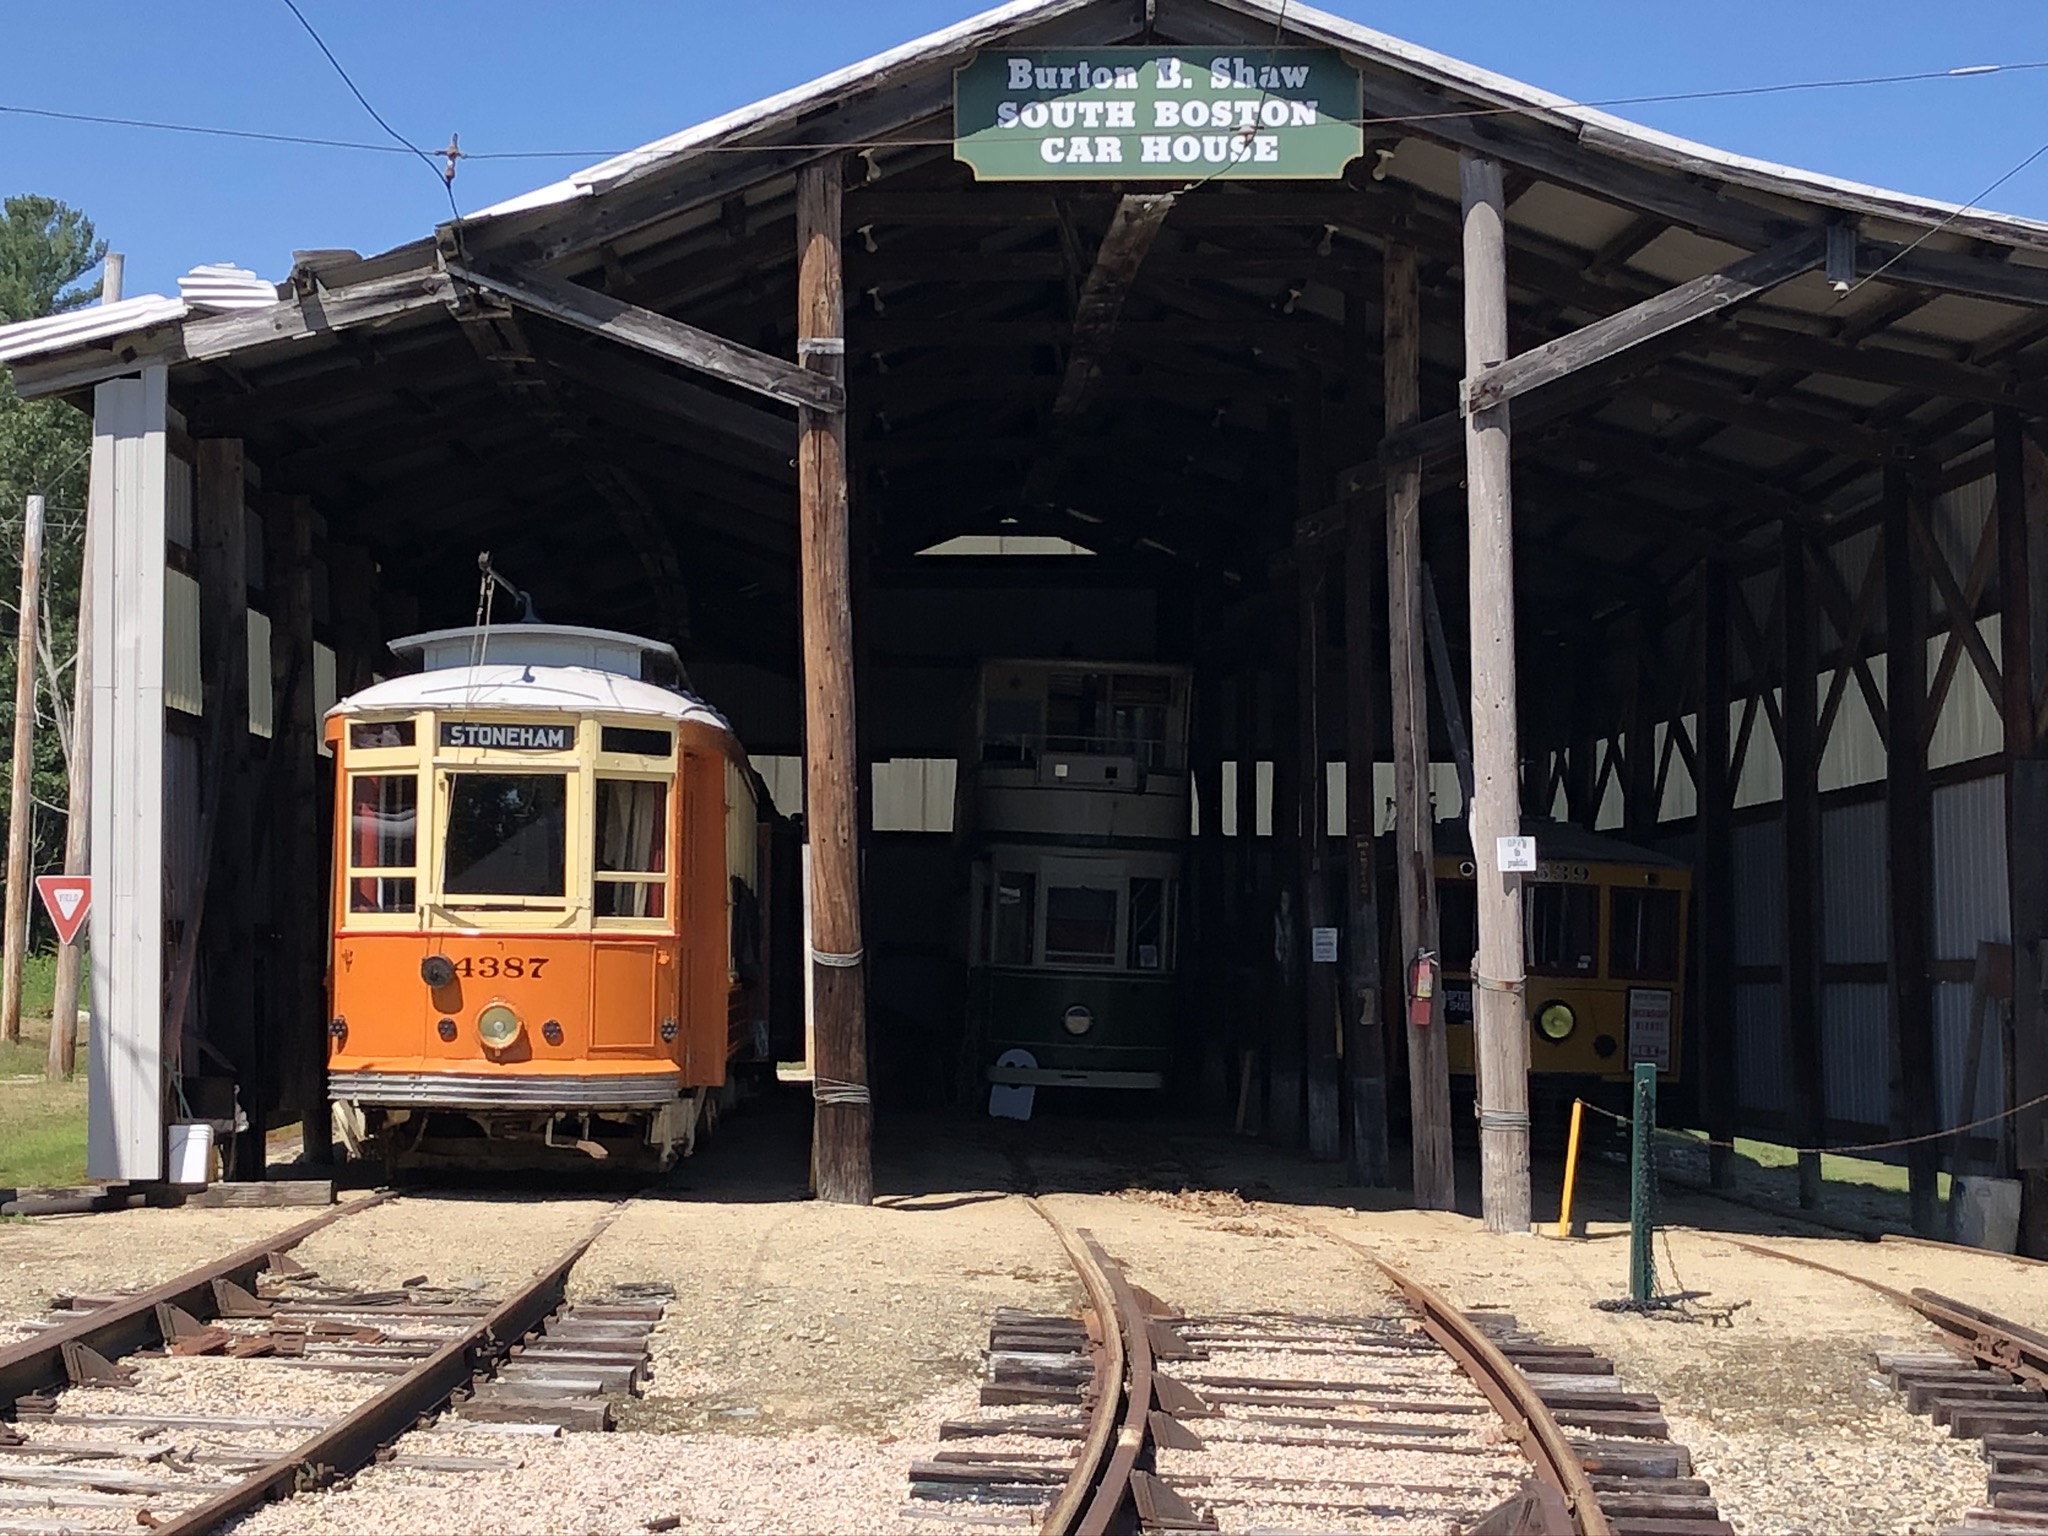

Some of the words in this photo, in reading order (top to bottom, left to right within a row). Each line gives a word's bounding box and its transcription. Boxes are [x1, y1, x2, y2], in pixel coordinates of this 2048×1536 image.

[1008, 58, 1138, 90] Burton
[1156, 58, 1192, 90] B.
[1210, 57, 1309, 89] Shaw
[997, 101, 1135, 128] SOUTH
[1154, 100, 1318, 127] BOSTON
[1040, 137, 1122, 163] CAR
[1141, 135, 1278, 162] HOUSE
[450, 725, 565, 748] STONEHAM
[58, 893, 80, 902] YIELD
[454, 957, 549, 979] 4387
